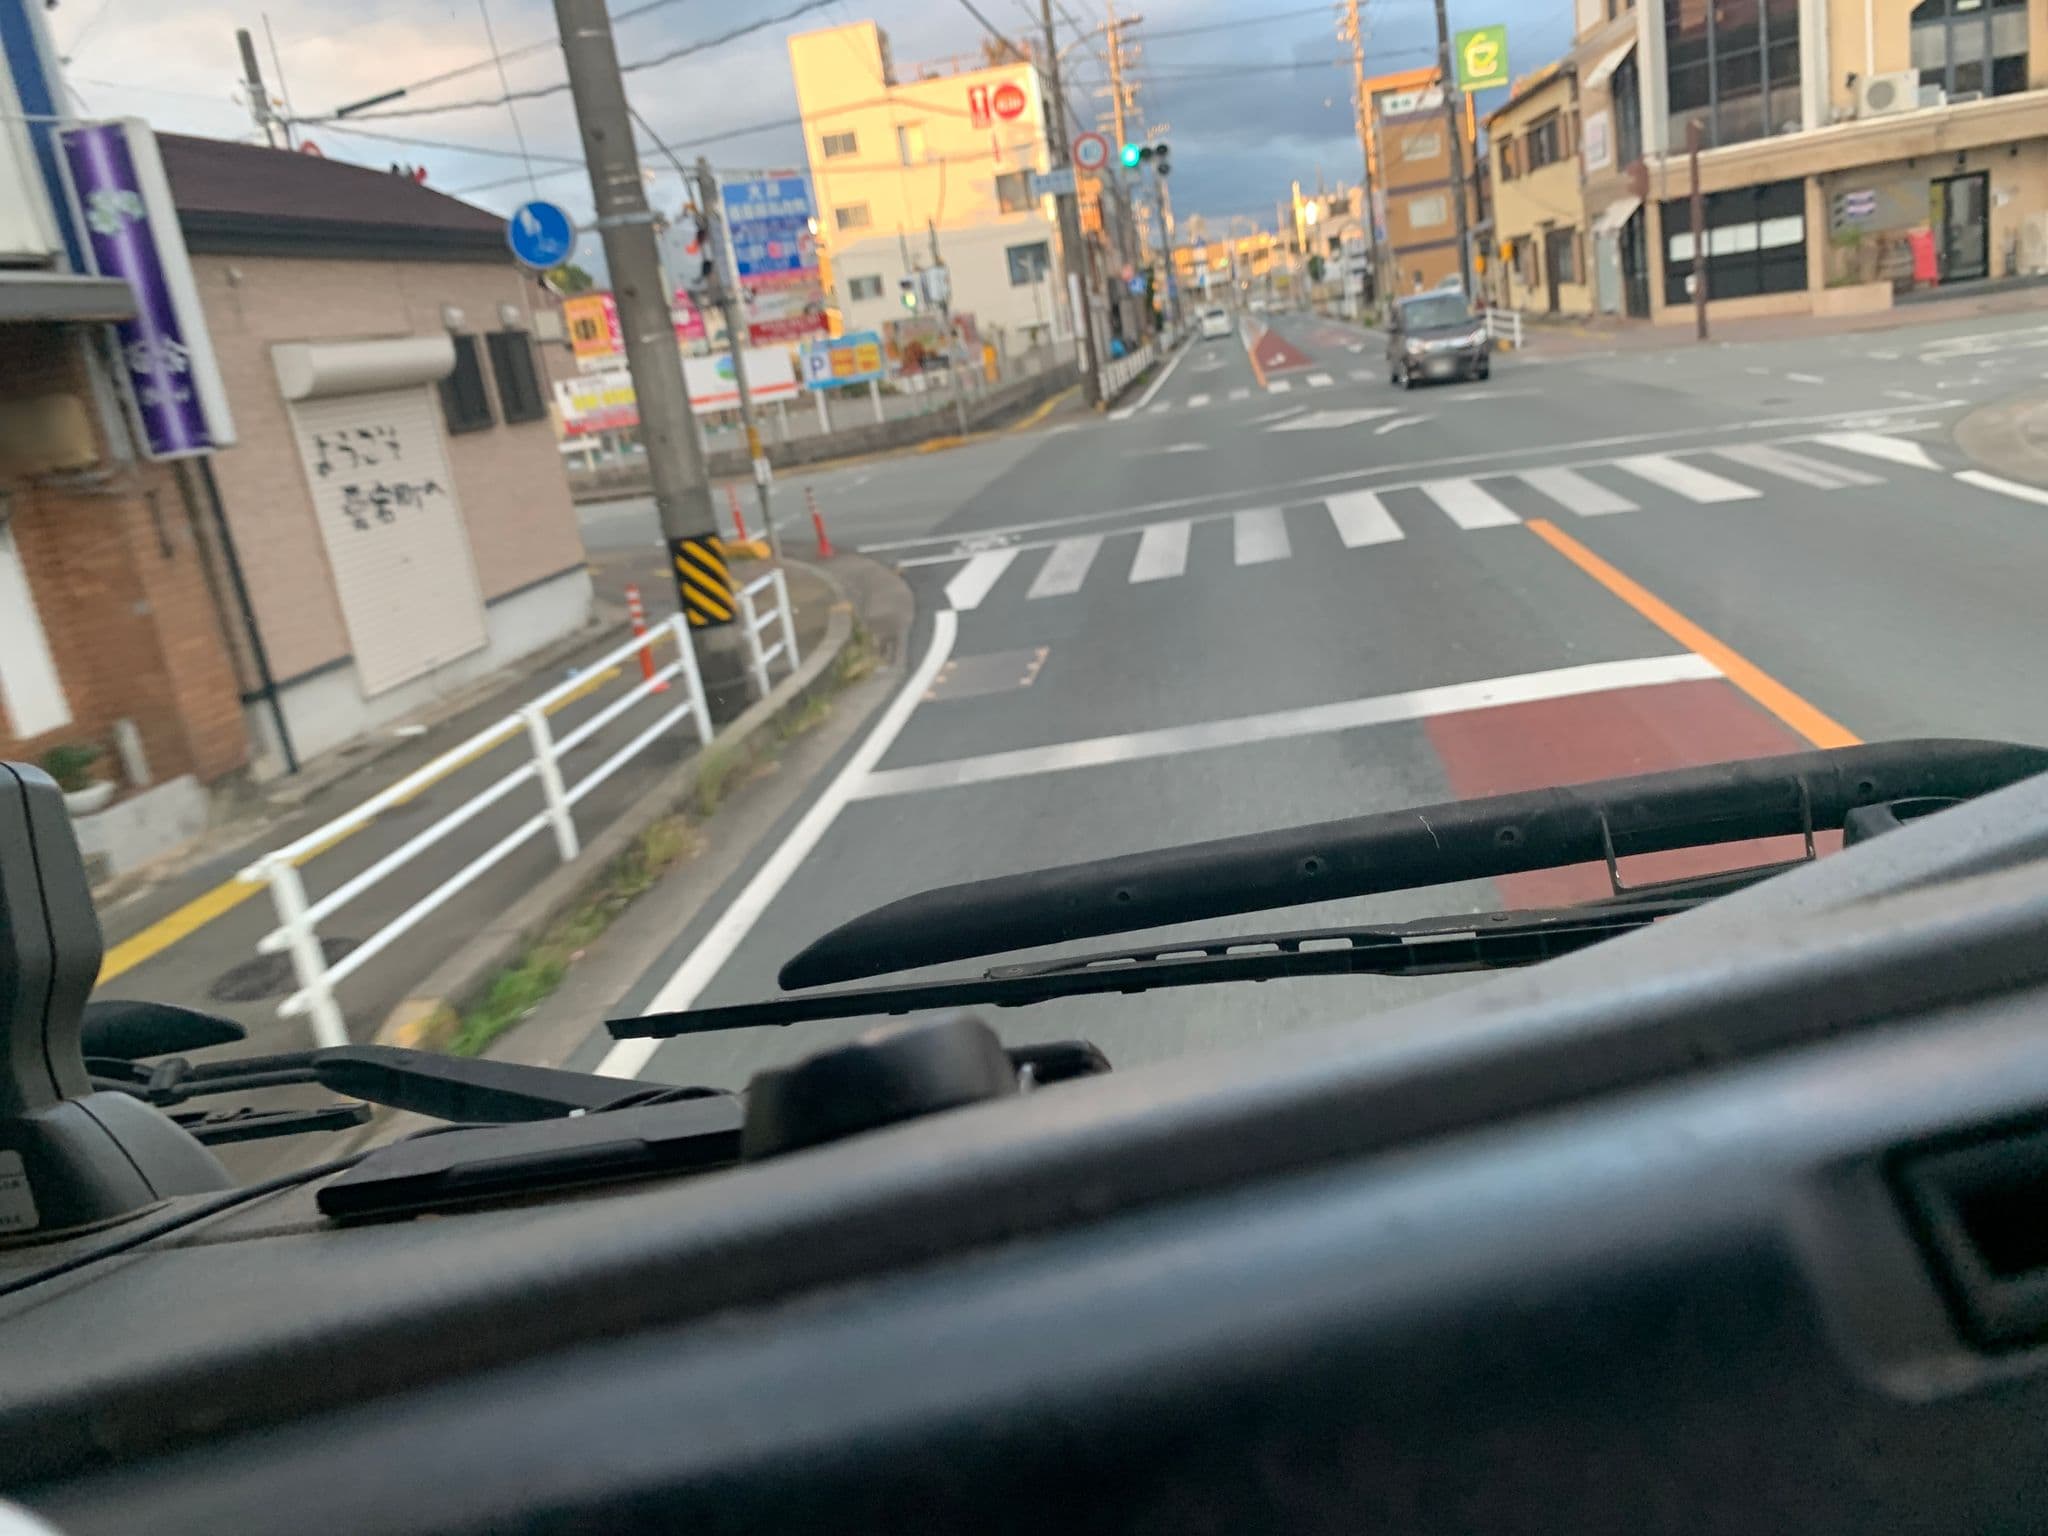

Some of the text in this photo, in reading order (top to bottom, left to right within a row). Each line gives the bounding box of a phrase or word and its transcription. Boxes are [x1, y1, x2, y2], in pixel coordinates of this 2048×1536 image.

[810, 355, 825, 378] P
[313, 425, 401, 477] ようこそ
